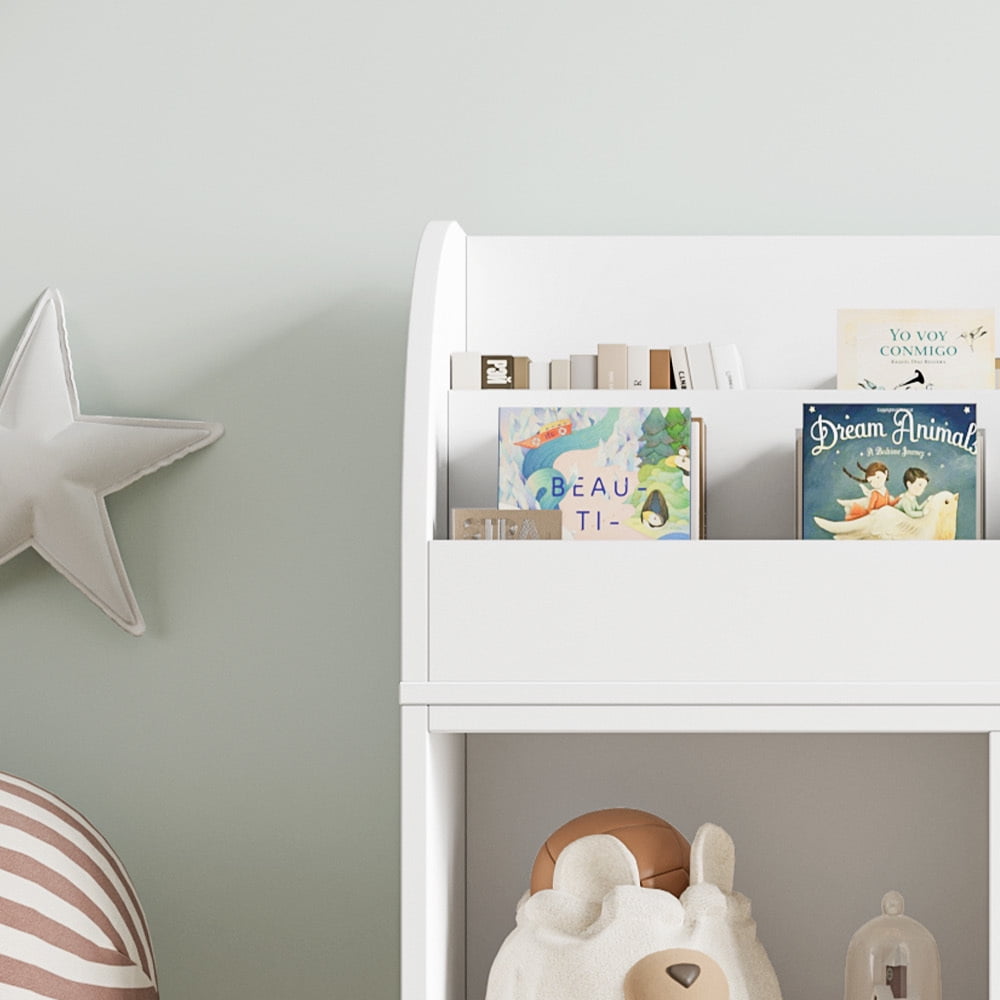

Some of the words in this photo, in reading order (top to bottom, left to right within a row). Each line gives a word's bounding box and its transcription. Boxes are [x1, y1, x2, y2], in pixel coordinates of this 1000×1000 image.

[879, 345, 958, 357] CONMIGO
[810, 414, 888, 456] Dream
[551, 477, 648, 497] BEAU-
[575, 511, 620, 531] TI-
